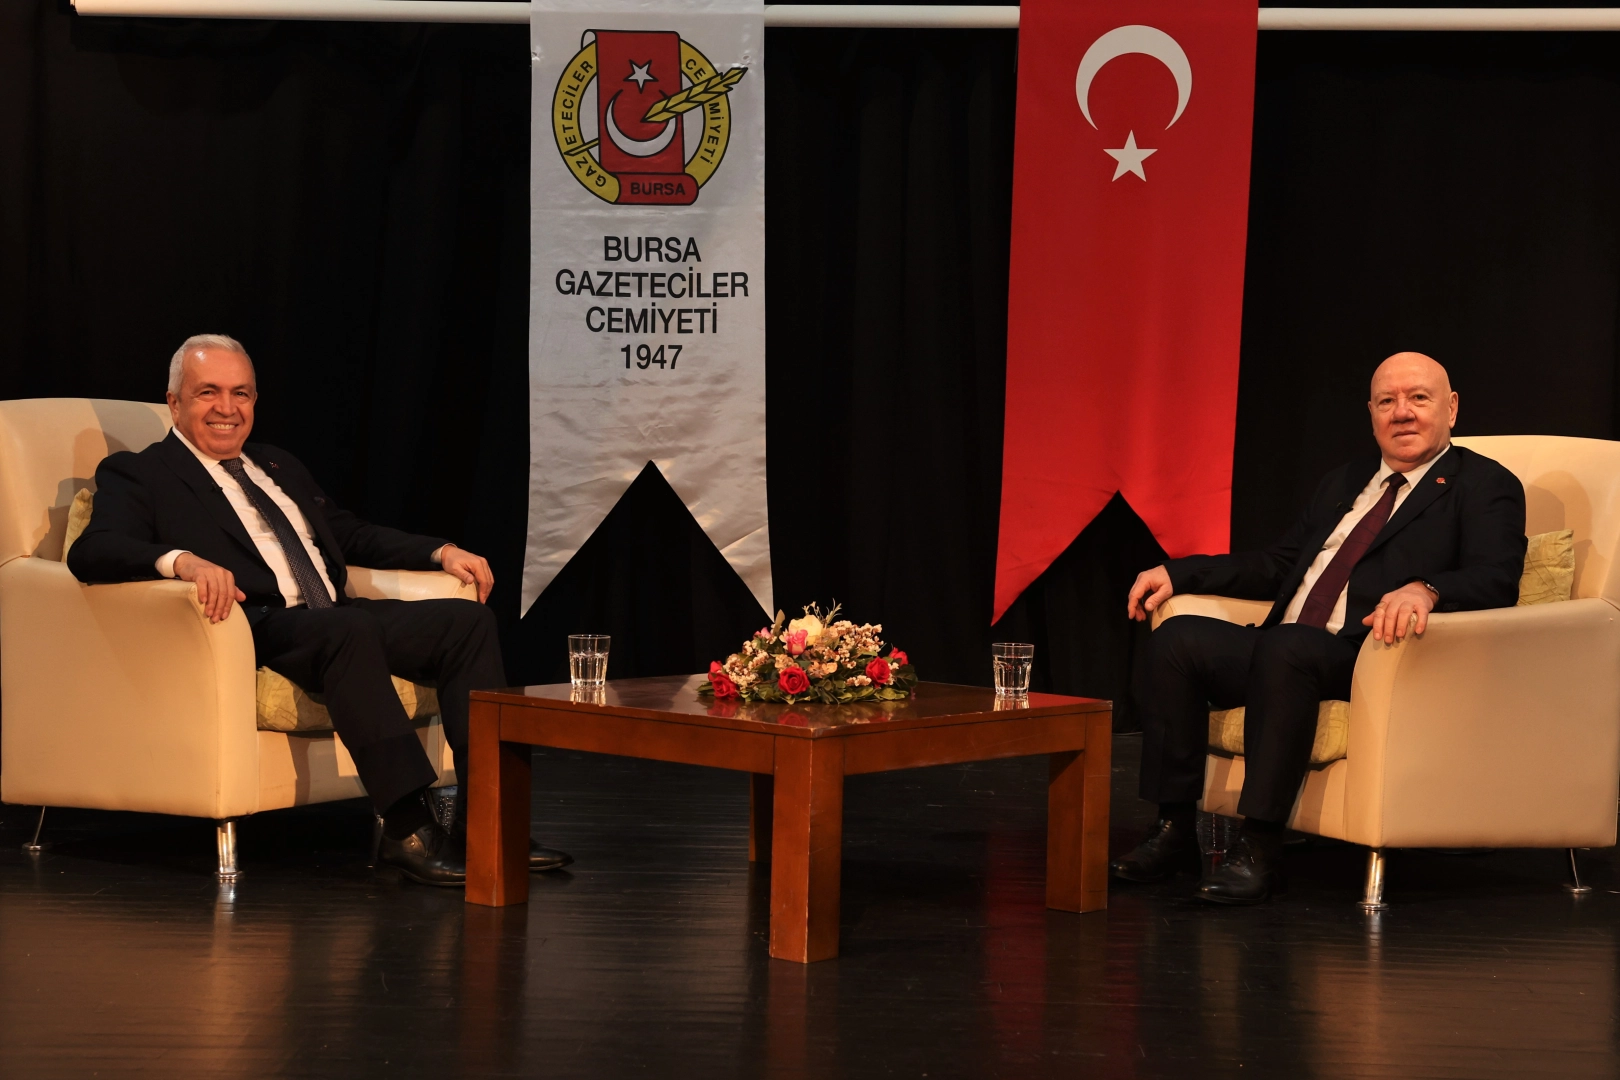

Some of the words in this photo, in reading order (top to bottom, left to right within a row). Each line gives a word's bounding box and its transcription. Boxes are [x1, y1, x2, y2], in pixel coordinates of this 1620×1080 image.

[630, 182, 686, 196] BURSA
[604, 235, 702, 263] BURSA
[555, 266, 749, 299] GAZETECİLER
[585, 302, 718, 334] CEMİYETİ
[620, 344, 683, 370] 1947
